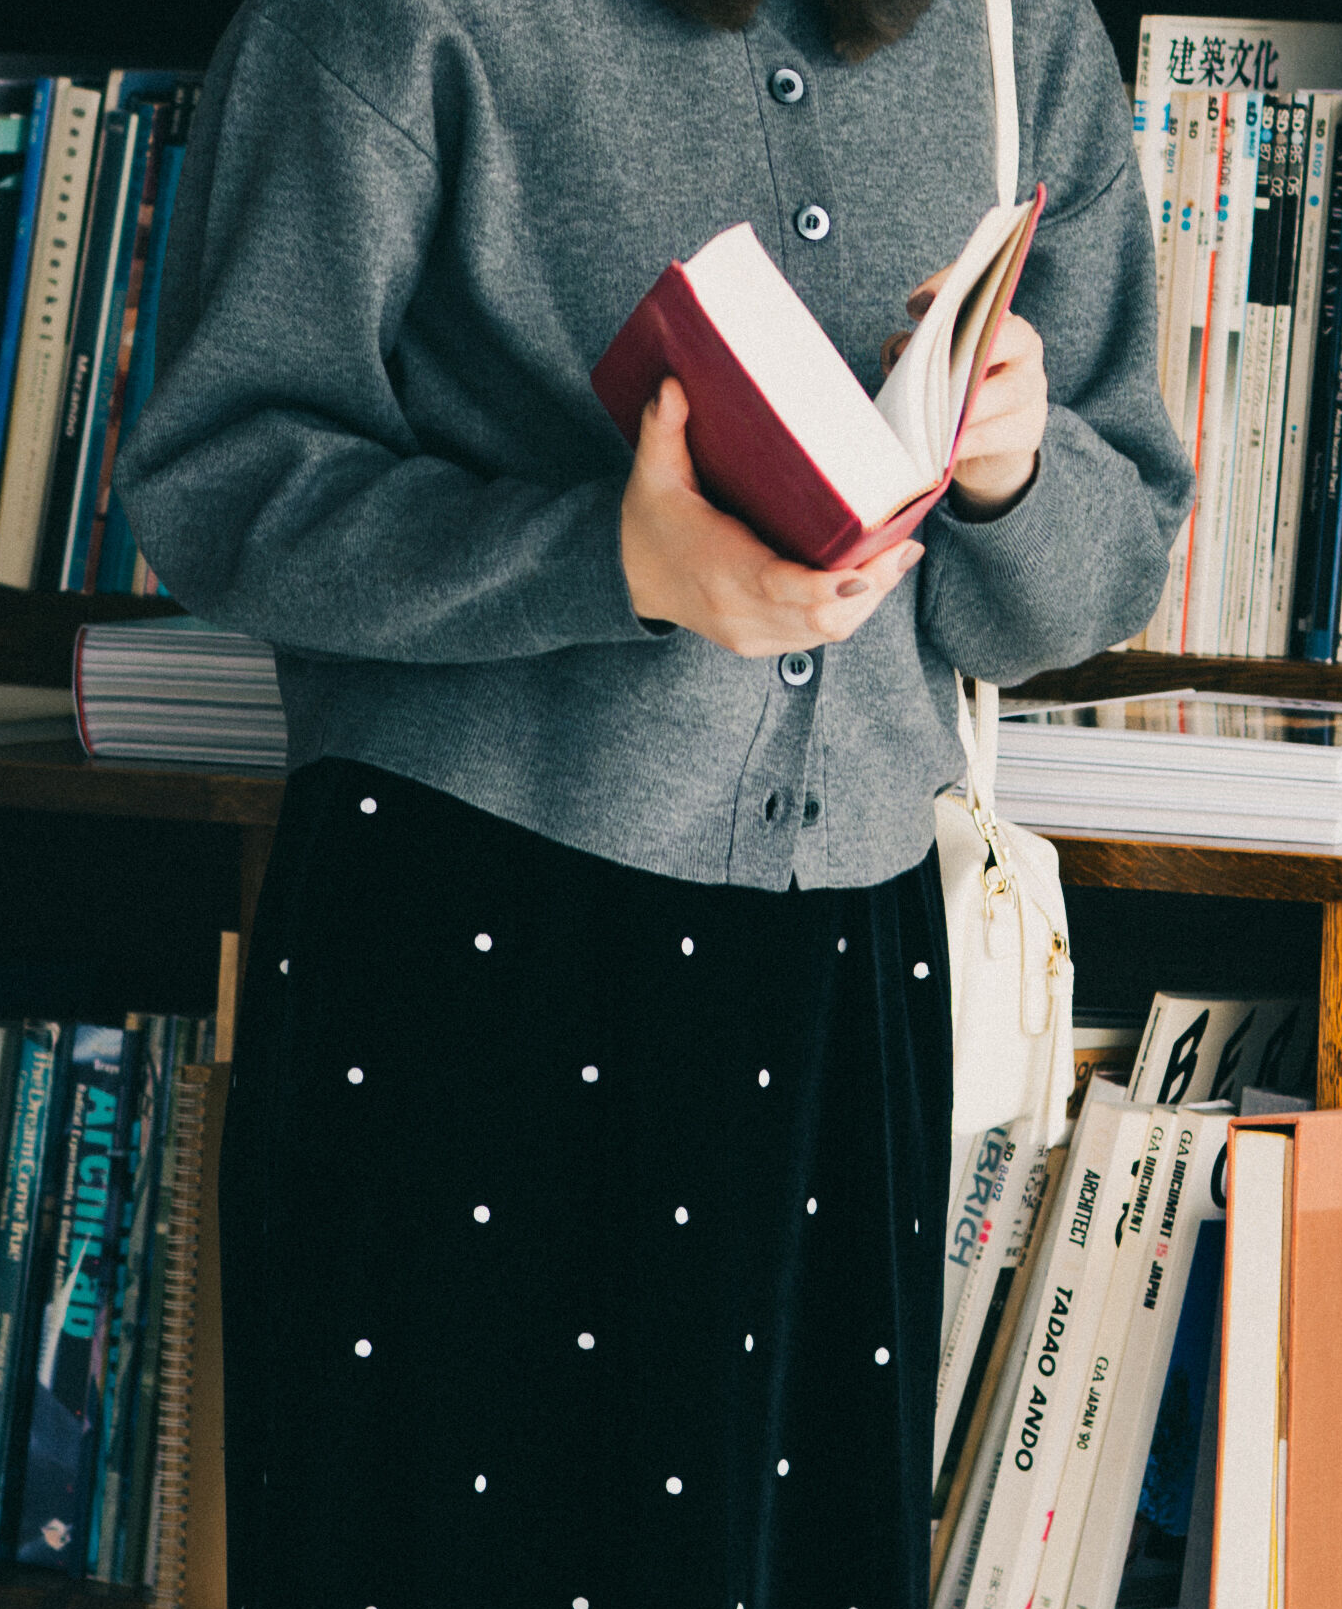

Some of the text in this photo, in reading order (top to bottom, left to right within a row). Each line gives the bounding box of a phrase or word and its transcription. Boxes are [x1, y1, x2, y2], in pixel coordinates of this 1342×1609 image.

[1166, 35, 1280, 90] 建築文化
[1168, 117, 1179, 136] SD
[1188, 120, 1199, 139] SD
[1207, 96, 1220, 121] SD
[1246, 101, 1259, 127] SD
[1261, 106, 1275, 130] SD
[1315, 118, 1327, 138] SD
[1260, 144, 1271, 162] 87
[1270, 109, 1290, 197] SD 86 02
[1286, 108, 1306, 196] SD 85 05
[65, 354, 88, 437] Mecanoo
[72, 1083, 86, 1125] Radical
[6, 1050, 52, 1262] The Dream Come True
[63, 1129, 80, 1200] Experiments
[1176, 1128, 1193, 1157] GA
[991, 1141, 1015, 1202] SD 8402
[1127, 1125, 1165, 1233] GA DOCUMENT
[62, 1085, 117, 1339] ArchiLab
[1158, 1159, 1187, 1239] DOCUMENT
[1142, 1260, 1165, 1310] JAPAN
[1015, 1168, 1103, 1473] ARCHITECT TADAO ANDO
[1091, 1355, 1109, 1383] GA
[1081, 1386, 1102, 1428] JAPAN
